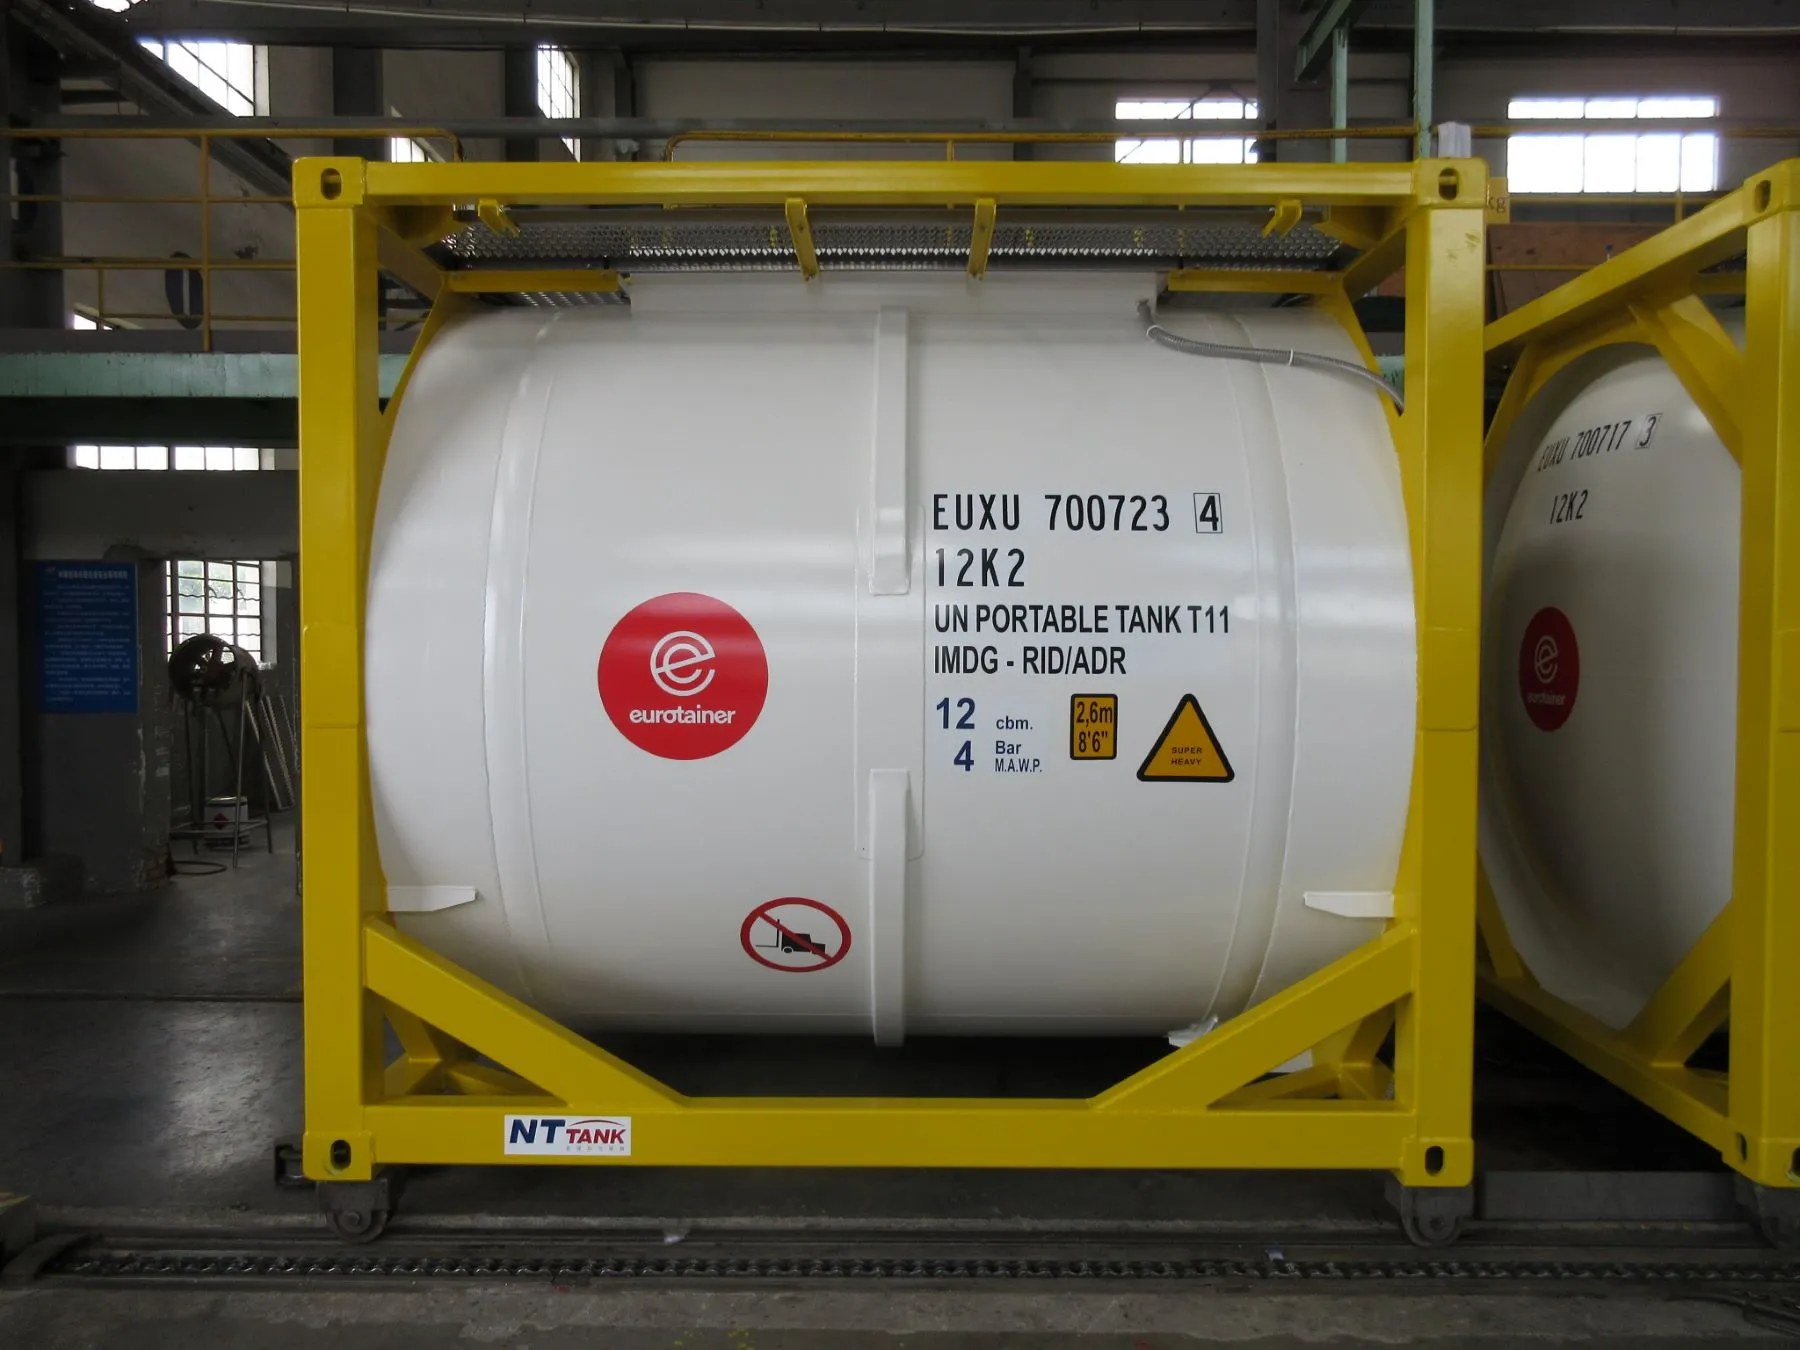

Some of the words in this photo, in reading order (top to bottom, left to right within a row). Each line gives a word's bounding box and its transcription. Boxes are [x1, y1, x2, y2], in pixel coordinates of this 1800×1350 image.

[1571, 420, 1632, 460] 700717
[1639, 416, 1657, 447] 3
[933, 494, 1020, 530] EUXU
[1045, 495, 1170, 531] 700723
[1200, 496, 1219, 531] 4
[1550, 489, 1588, 524] 12K2
[935, 548, 1026, 587] 12K2
[934, 604, 969, 632] UN
[976, 605, 1109, 633] PORTABLE
[1115, 605, 1182, 633] TANK
[1187, 605, 1229, 633] T11
[934, 646, 999, 675] IMDG
[1023, 646, 1127, 675] RID/ADR
[629, 704, 736, 724] eurotainer
[936, 697, 976, 729] 12
[996, 716, 1034, 730] cbm.
[1076, 701, 1113, 728] 2,6m
[953, 740, 975, 772] 4
[995, 740, 1022, 755] Bar
[1171, 746, 1203, 754] SUPER
[1171, 758, 1201, 766] HEAVY
[994, 758, 1043, 773] M.A.W.P.
[509, 1119, 566, 1144] NT
[566, 1128, 626, 1145] TANK
